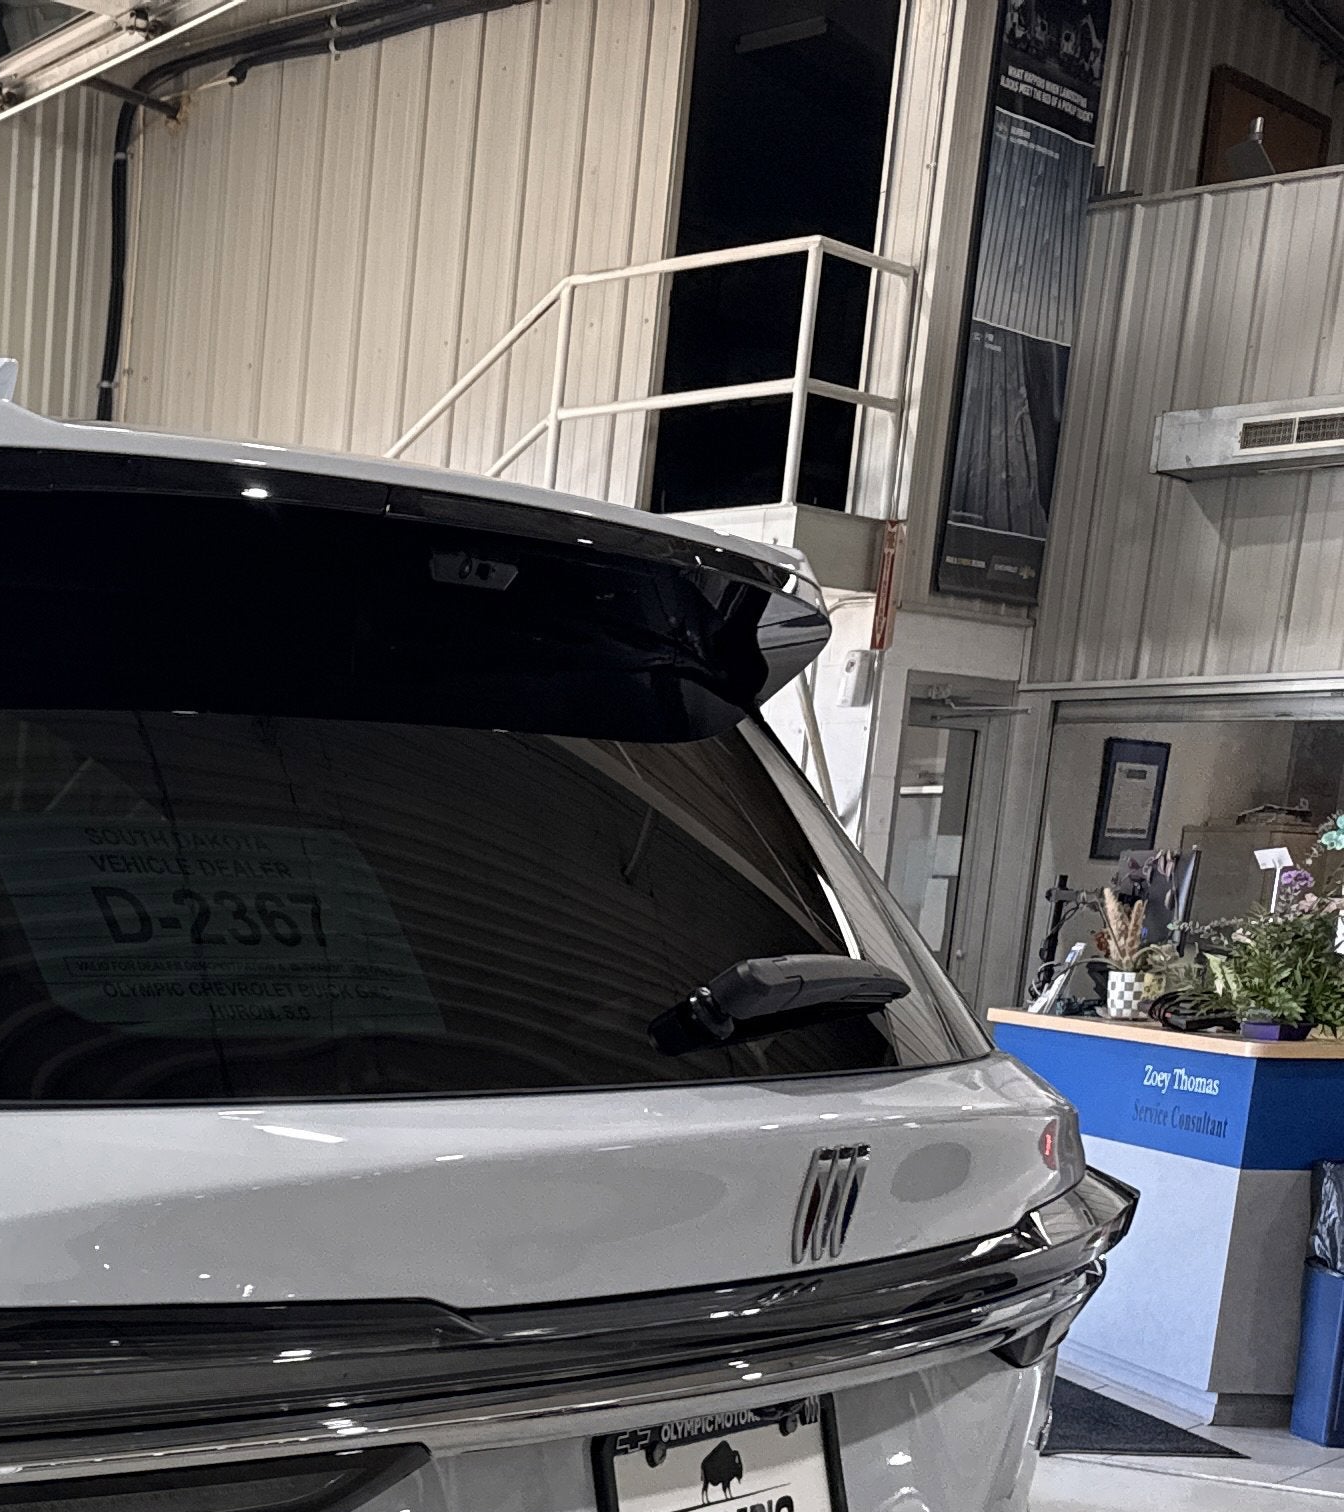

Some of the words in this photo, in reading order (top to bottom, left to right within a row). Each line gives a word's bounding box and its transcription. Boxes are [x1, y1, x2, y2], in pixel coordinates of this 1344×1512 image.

[89, 854, 191, 876] VEHICLE
[196, 857, 292, 878] DEALER
[91, 886, 327, 946] D-2367
[103, 981, 184, 998] OLYMPIC
[188, 981, 294, 998] CHEVROLET
[298, 983, 354, 999] BUICK
[1143, 1064, 1171, 1094] Zoey
[1173, 1068, 1220, 1095] Thomas
[1133, 1098, 1168, 1127] Service
[1171, 1104, 1229, 1139] Consultant
[661, 1415, 714, 1443] OLYMPIC
